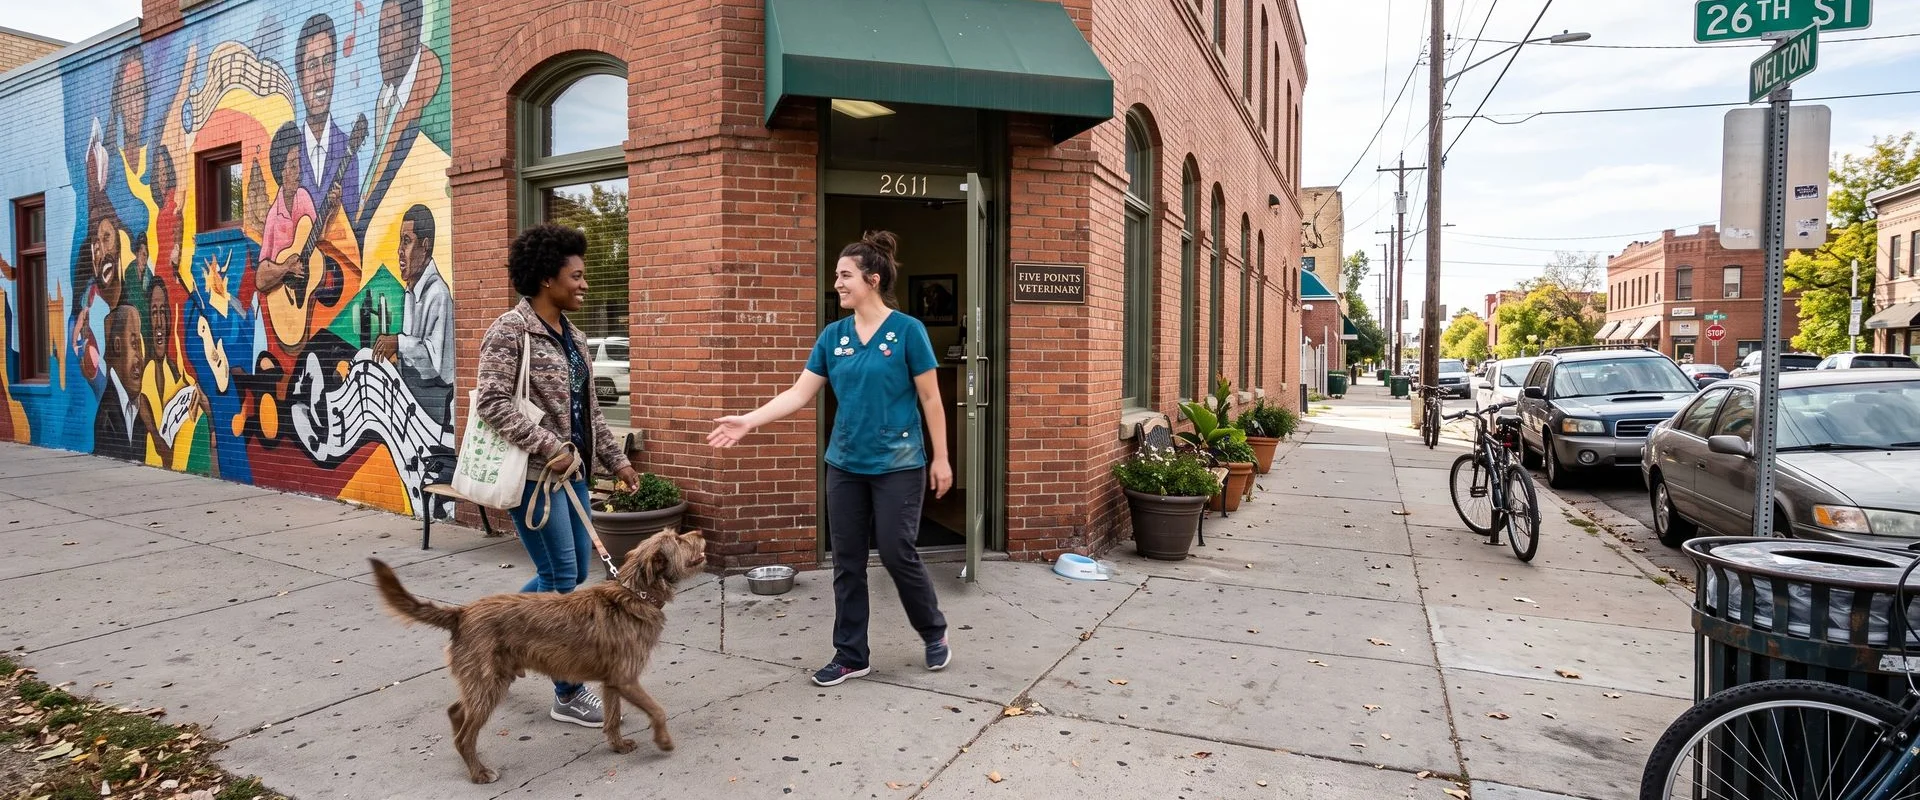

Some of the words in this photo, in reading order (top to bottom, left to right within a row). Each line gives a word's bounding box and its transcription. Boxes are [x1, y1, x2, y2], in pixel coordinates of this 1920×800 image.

[1707, 0, 1790, 36] 26TH
[1754, 34, 1811, 94] WELTON
[880, 174, 927, 196] 2611
[1019, 272, 1041, 282] FIVE
[1043, 273, 1081, 283] POINTS
[1018, 283, 1081, 294] VETERINARY
[1707, 329, 1725, 337] STOP
